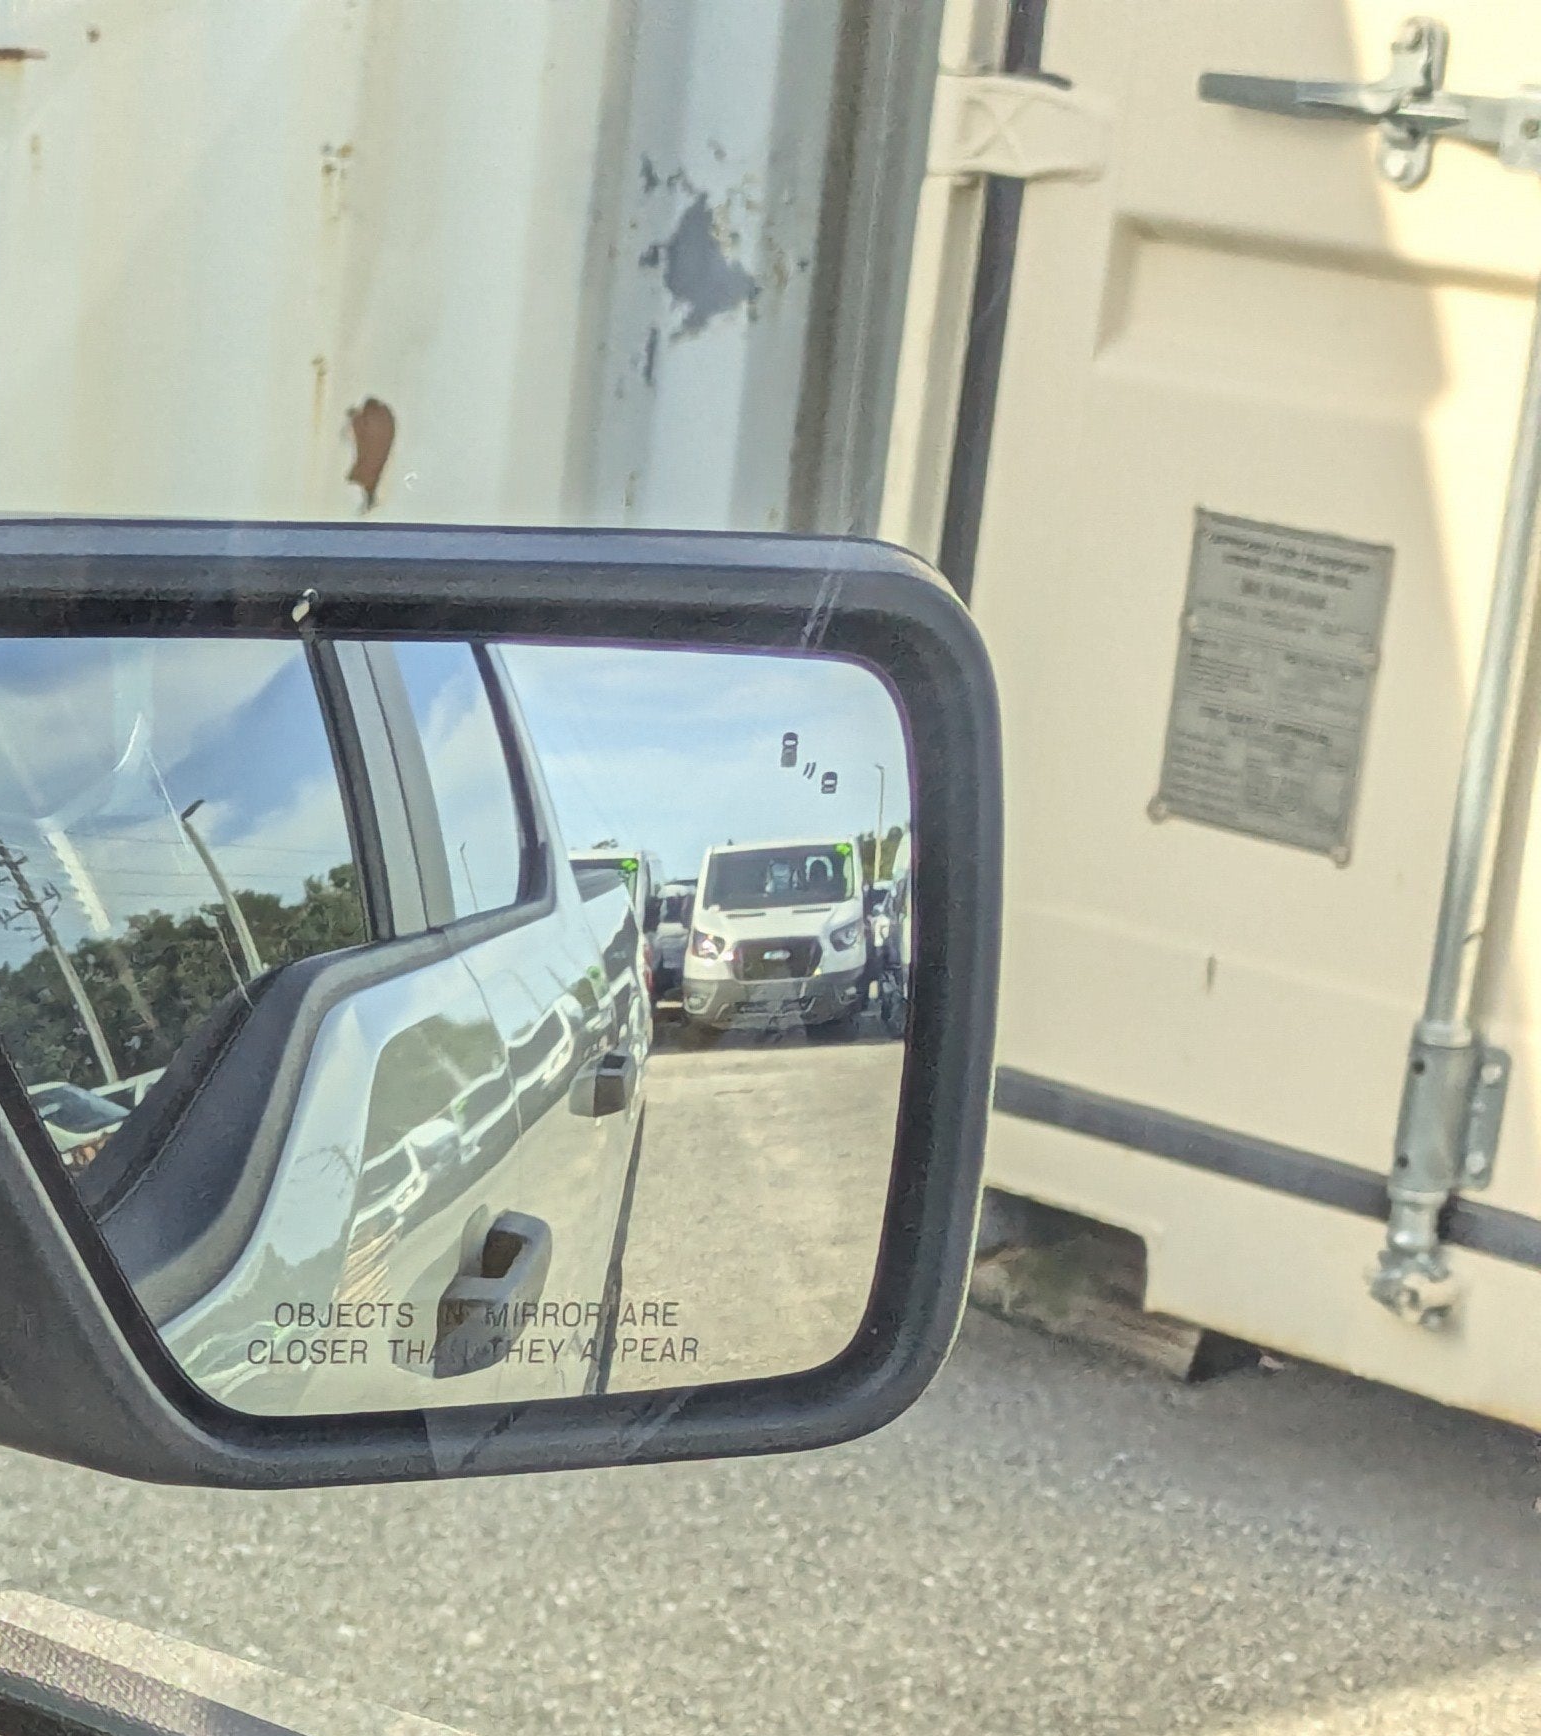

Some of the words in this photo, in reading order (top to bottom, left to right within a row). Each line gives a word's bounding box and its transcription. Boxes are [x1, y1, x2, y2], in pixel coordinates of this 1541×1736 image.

[274, 1302, 414, 1328] OBJECTS
[619, 1302, 680, 1326] ARE
[247, 1339, 367, 1364] CLOSER
[487, 1337, 565, 1363] THEY
[579, 1336, 699, 1362] APEAR
